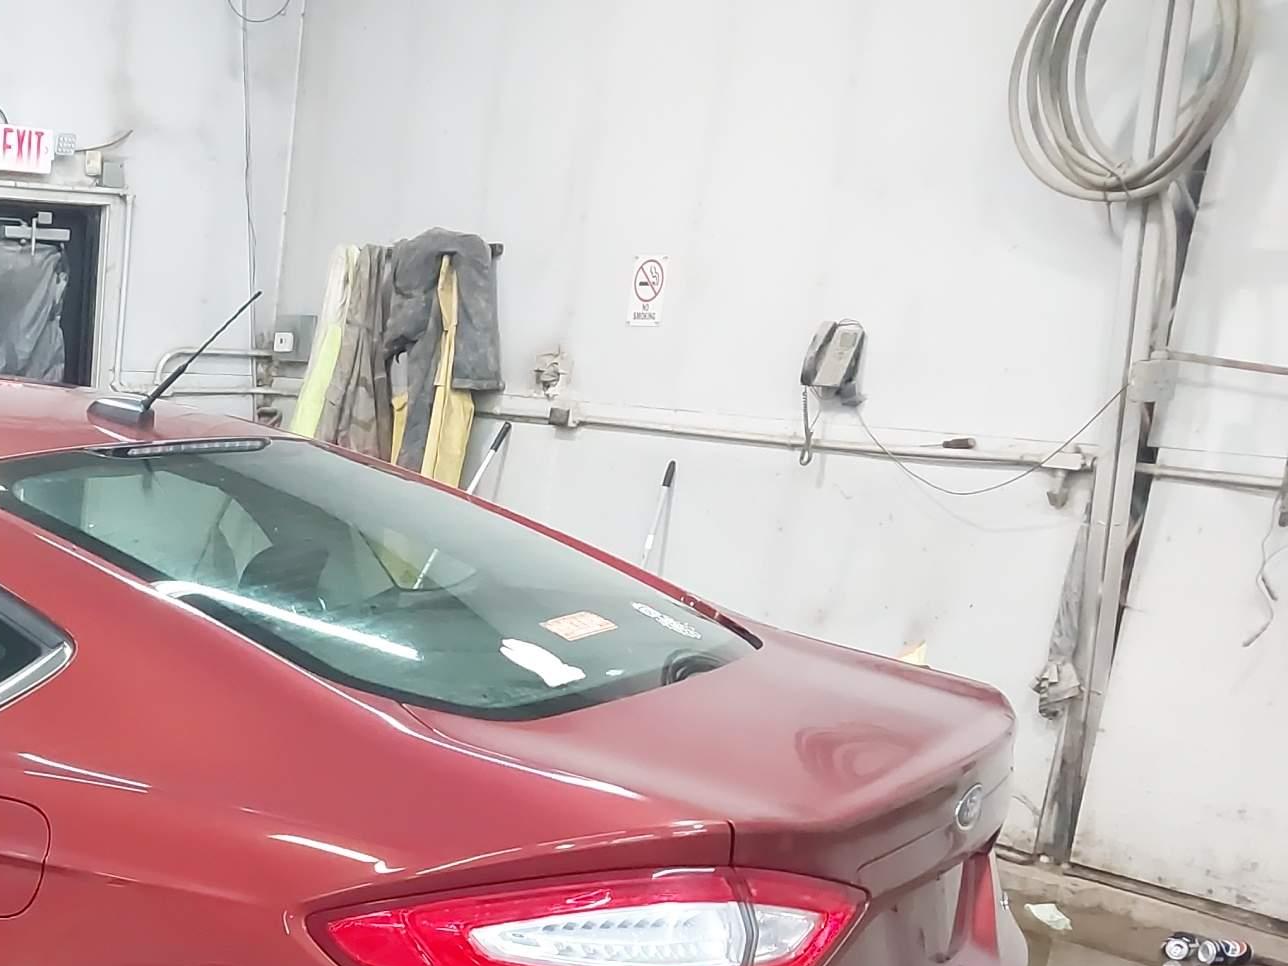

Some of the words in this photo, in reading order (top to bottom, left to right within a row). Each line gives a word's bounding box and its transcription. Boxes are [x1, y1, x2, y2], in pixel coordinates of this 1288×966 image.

[2, 127, 45, 165] EXIT
[642, 303, 650, 312] NO
[633, 311, 656, 321] SMOKING
